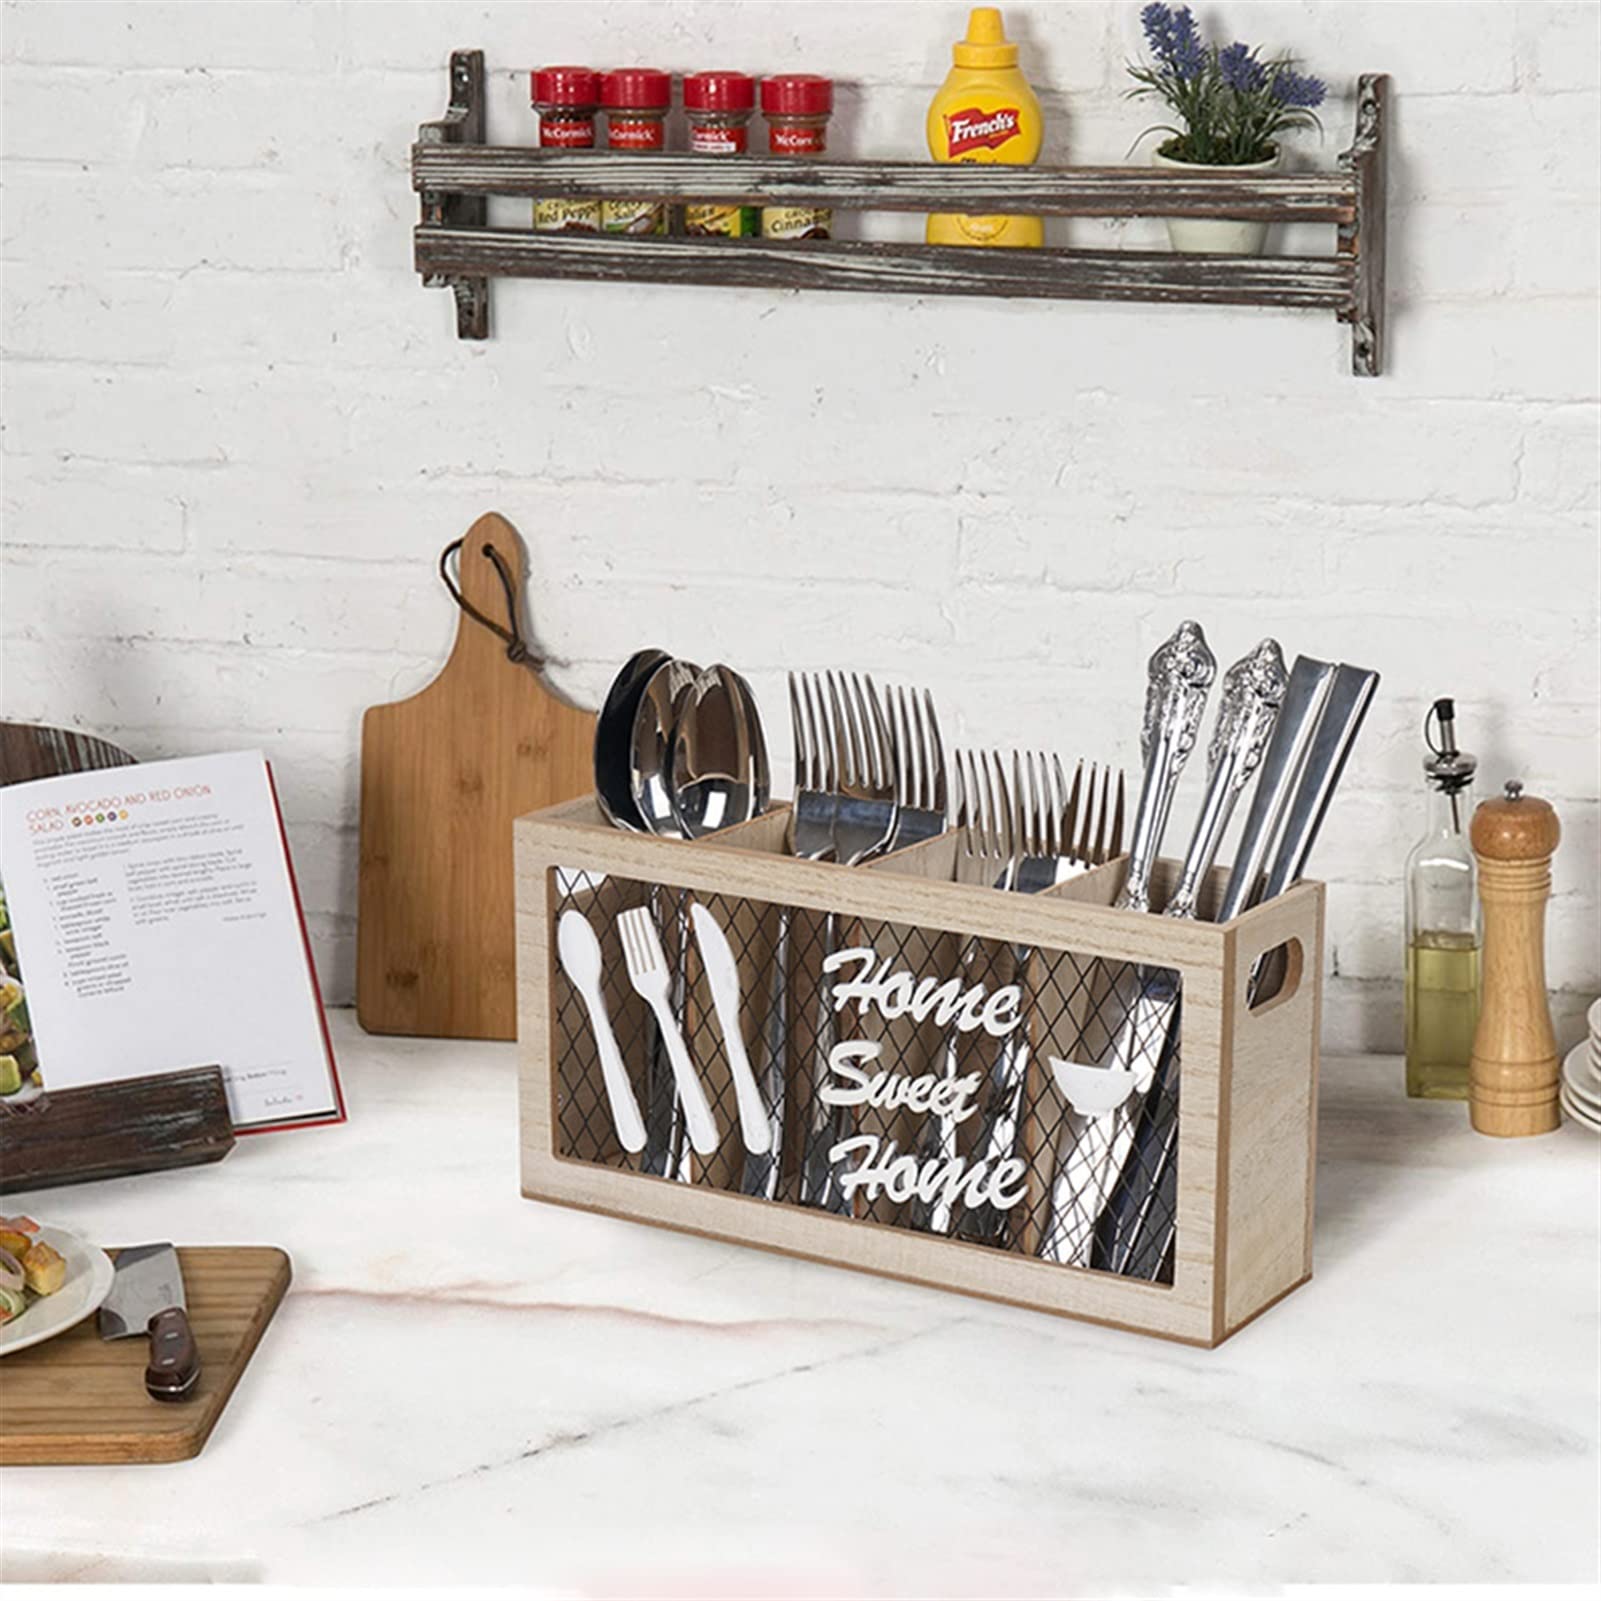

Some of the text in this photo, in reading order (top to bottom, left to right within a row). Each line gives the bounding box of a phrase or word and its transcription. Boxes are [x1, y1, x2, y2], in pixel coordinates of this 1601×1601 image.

[951, 112, 1015, 143] French's
[66, 796, 122, 813] AVOCADO
[125, 792, 146, 805] AND
[150, 789, 171, 802] RED
[173, 784, 212, 799] ONION
[29, 819, 64, 835] SALAD
[823, 947, 1023, 1037] Home
[820, 1040, 982, 1123] Sweet
[828, 1135, 1029, 1210] Home
